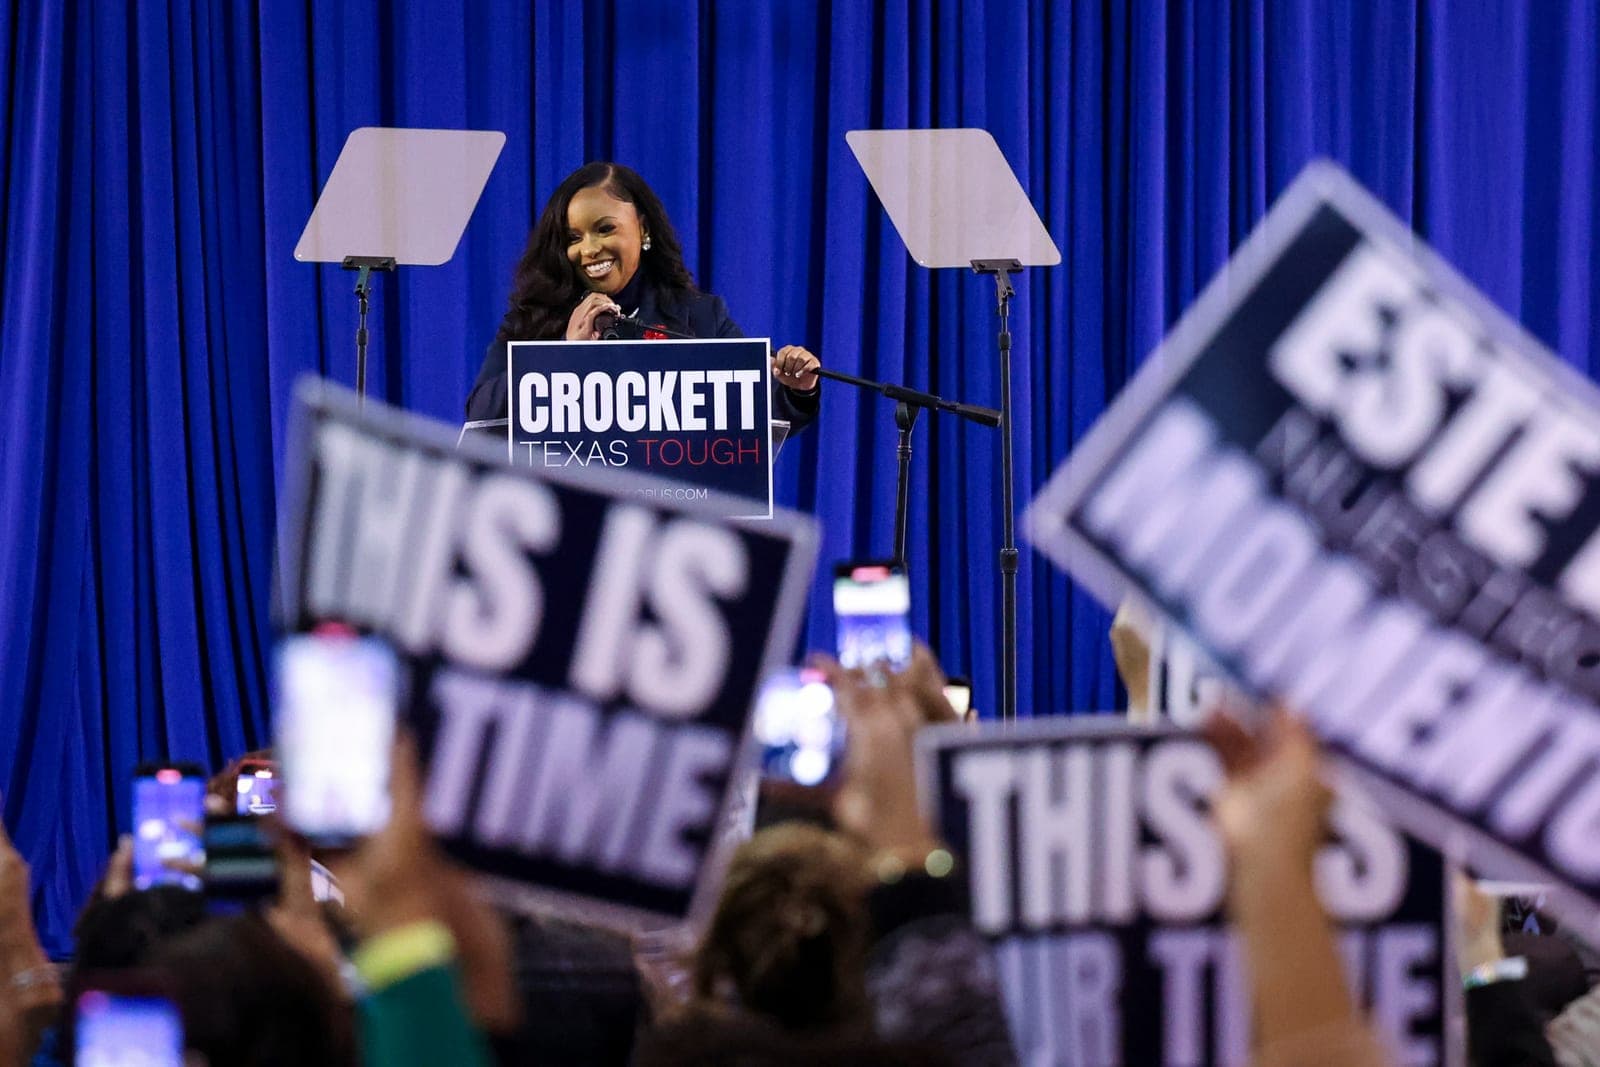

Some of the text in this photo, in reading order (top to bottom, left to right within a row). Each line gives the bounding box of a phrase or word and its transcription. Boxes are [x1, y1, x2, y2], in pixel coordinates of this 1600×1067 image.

[519, 370, 761, 433] CROCKETT
[519, 438, 760, 467] TEXAS TOUGH
[1268, 238, 1600, 570] ESTE
[307, 423, 749, 718] THIS IS
[424, 675, 733, 878] TIME
[953, 738, 1410, 935] THIS S
[1000, 924, 1438, 1067] UR TIE
